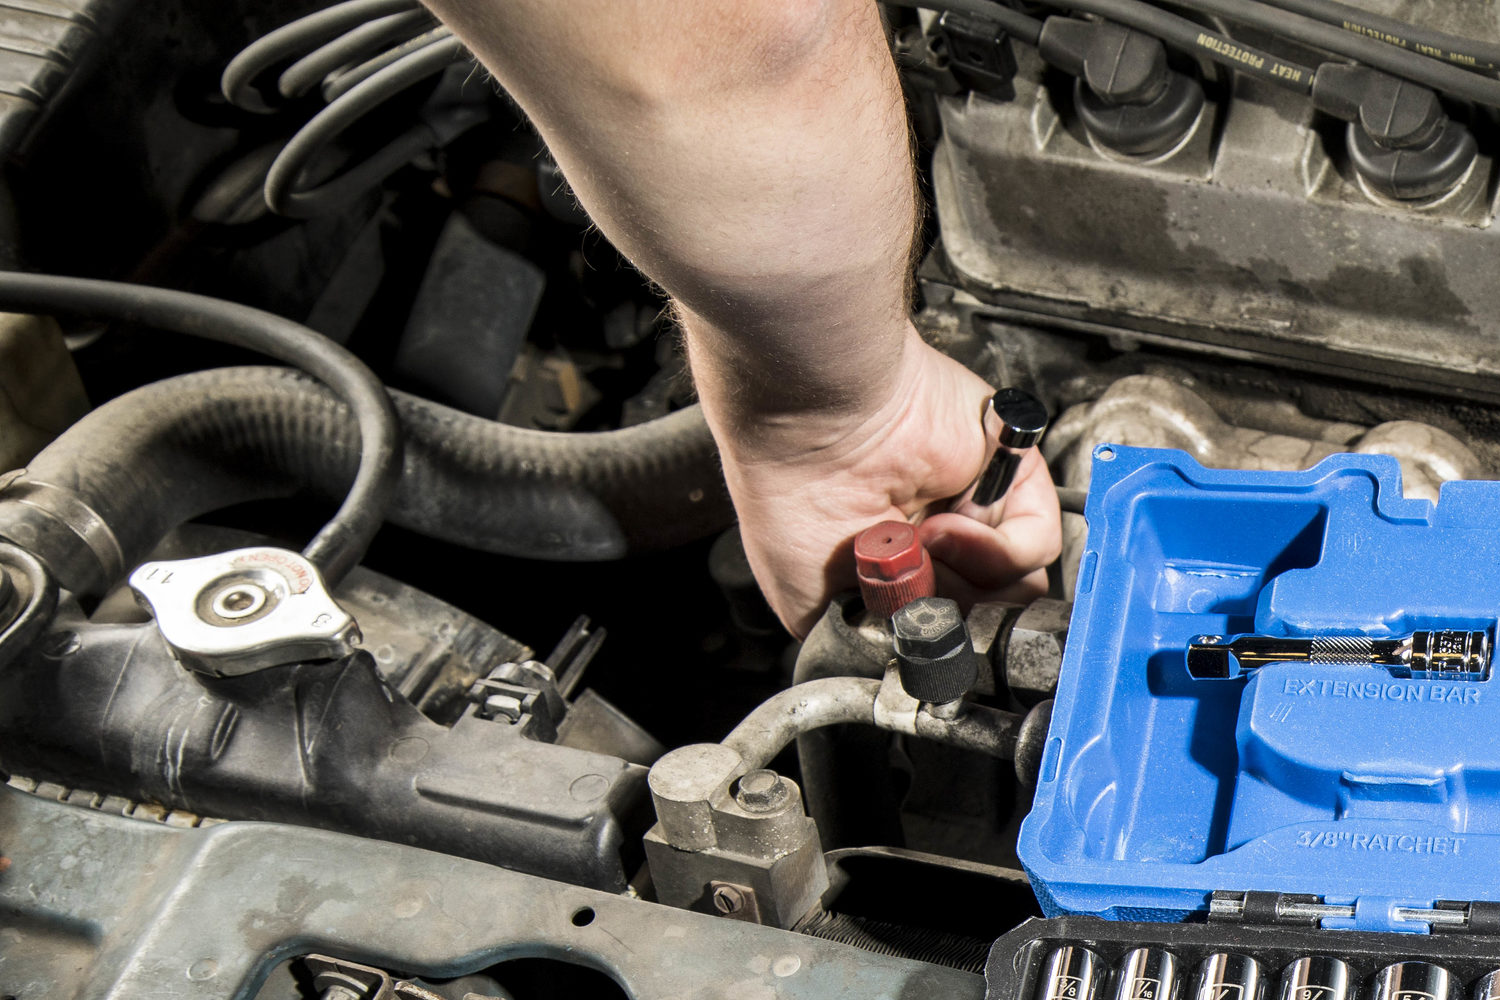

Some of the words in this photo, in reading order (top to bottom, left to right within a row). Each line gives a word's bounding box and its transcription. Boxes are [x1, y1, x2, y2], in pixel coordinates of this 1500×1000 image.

[1197, 32, 1264, 69] PROTECTION
[1269, 63, 1303, 82] HEAT
[1281, 678, 1425, 702] EXTENSION
[1429, 684, 1482, 705] BAR
[1351, 832, 1468, 855] RATCHET
